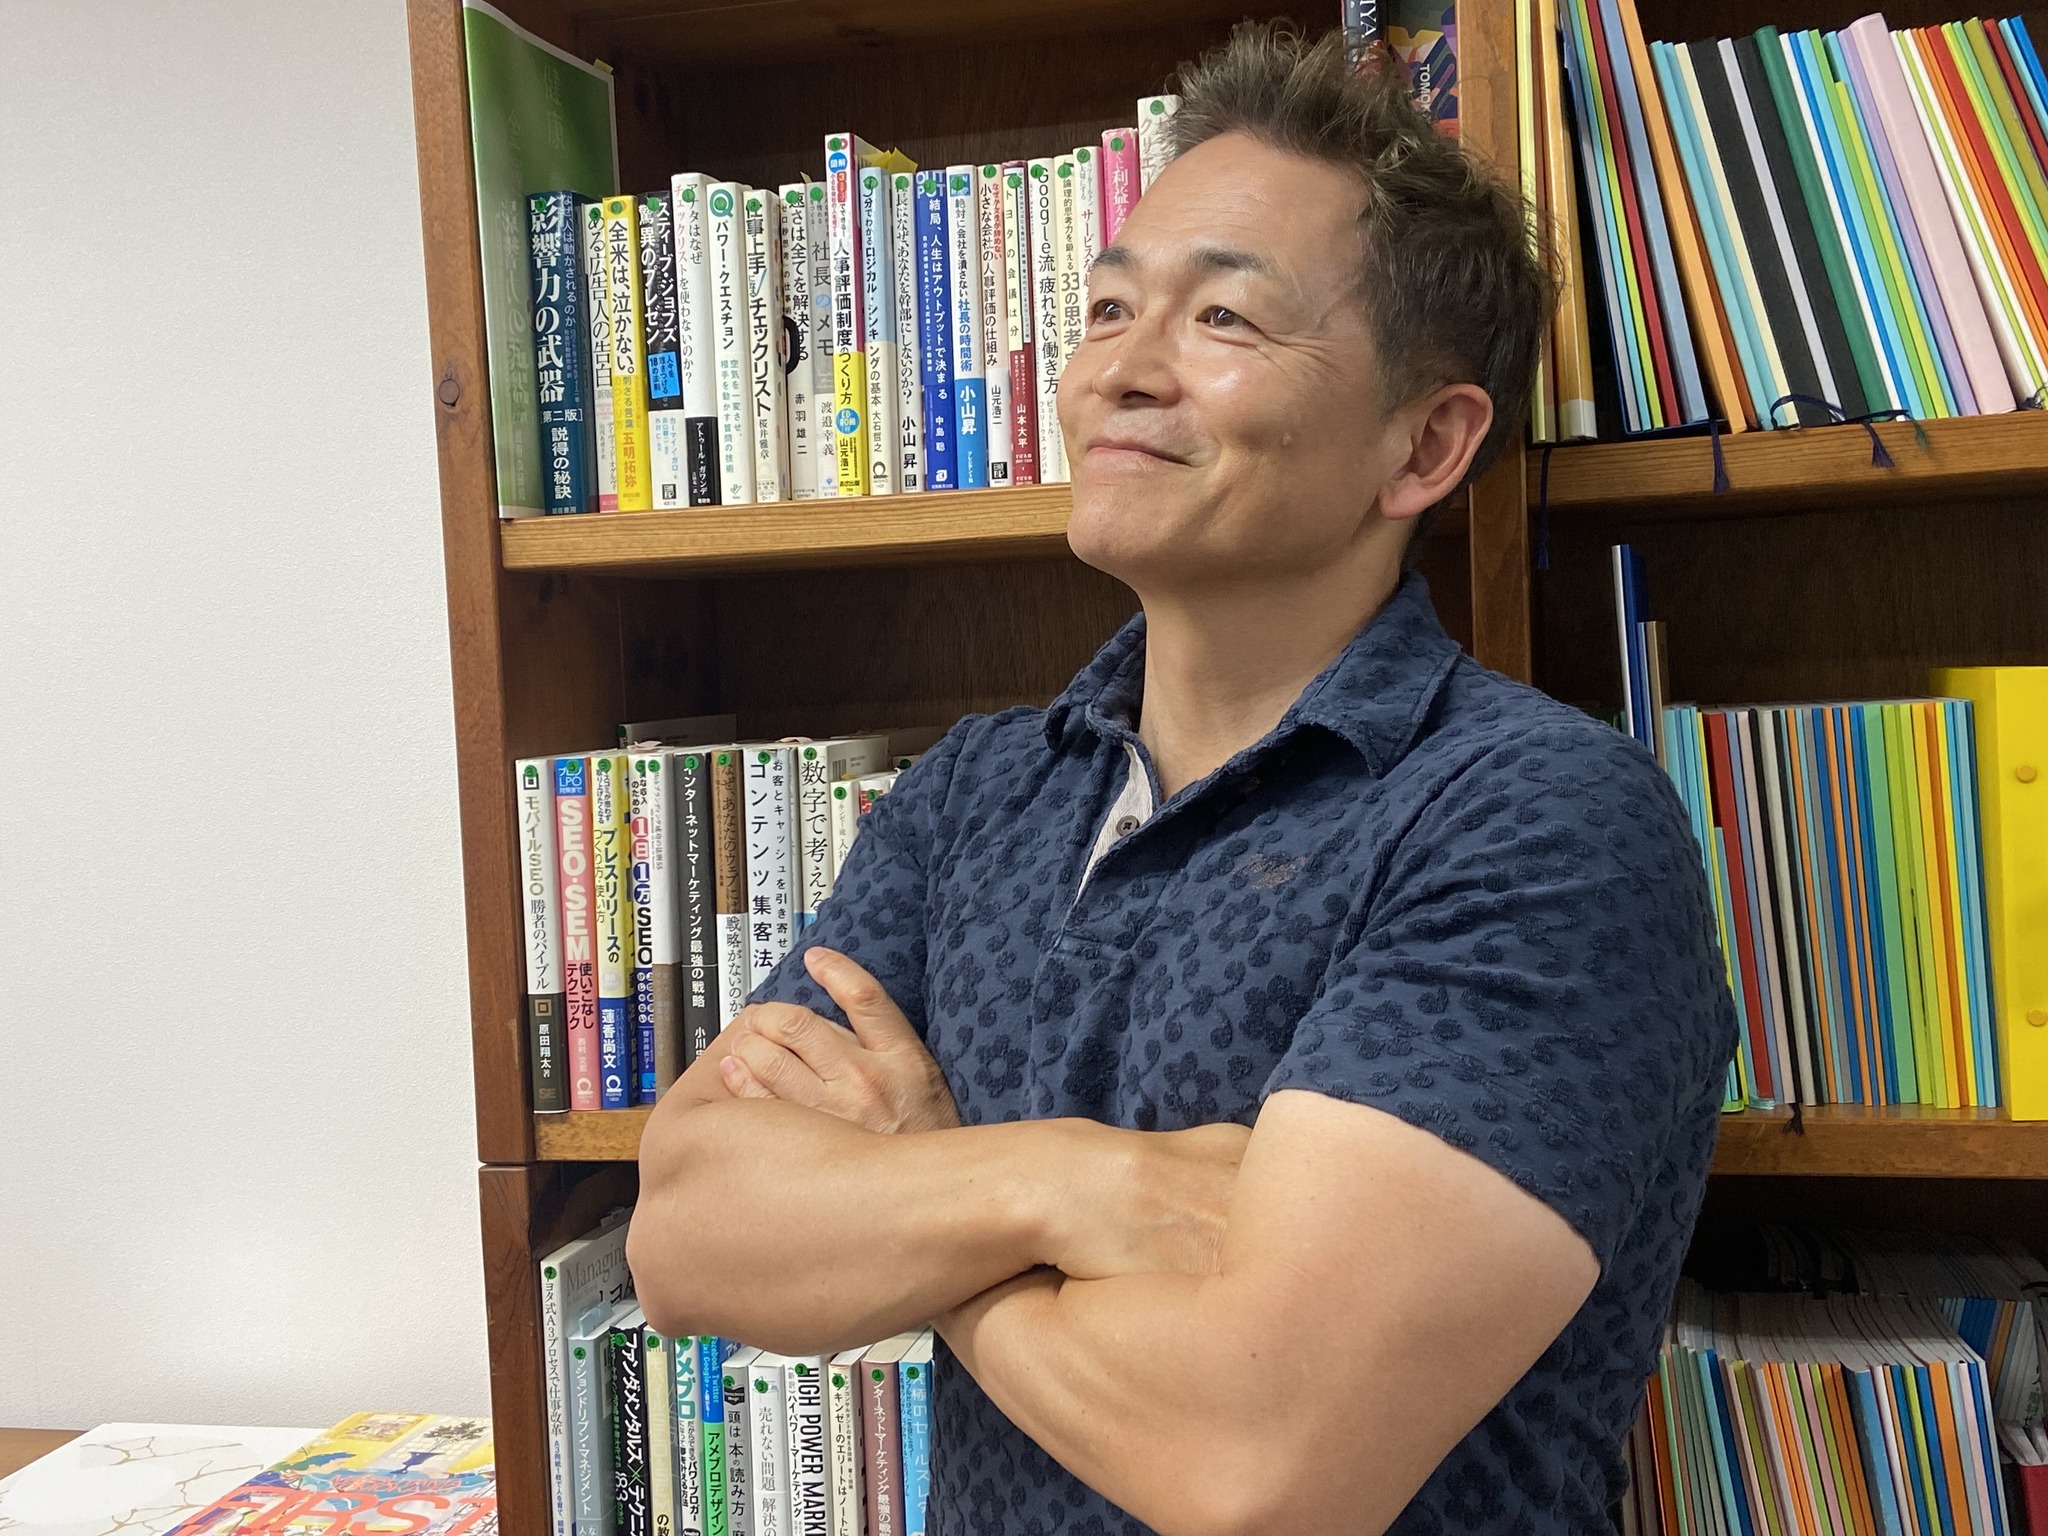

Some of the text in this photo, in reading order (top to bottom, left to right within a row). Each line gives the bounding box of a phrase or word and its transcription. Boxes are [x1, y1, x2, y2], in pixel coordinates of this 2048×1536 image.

[1113, 150, 1130, 240] ぐに利益を
[530, 195, 567, 405] 影響力の武器
[609, 220, 636, 375] 全米は、泣かない。
[639, 204, 660, 346] 驚異のプレゼン
[656, 202, 678, 344] スティーブ・ジョブズ
[716, 221, 735, 350] パワー・クエスチョン
[812, 240, 834, 357] 社長のメモ
[834, 240, 854, 406] 人事評価制度のつくり方
[895, 187, 915, 405] 長はなぜ、あなたを幹部にしないのか?
[929, 199, 949, 400] 結局、人生はアウトプットで決まる
[954, 198, 973, 373] 絶対に会社を潰さない社長の時間術
[980, 183, 998, 367] 小さな会社の人事評価の仕組み
[1039, 275, 1060, 395] 疲れない働き方
[551, 427, 572, 500] 説得の秘訣
[623, 432, 637, 488] 五明拓弥
[720, 361, 735, 475] 相手を動かす質問の技術
[795, 393, 807, 455] 赤羽雄二
[960, 385, 977, 436] 小山昇
[1015, 404, 1028, 449] 山本大平
[559, 777, 583, 788] LPO
[632, 780, 642, 815] のための
[524, 796, 545, 897] モバイルSEO
[603, 828, 622, 963] プレスリリースの
[750, 763, 774, 969] コンテンツ集客法
[531, 900, 550, 991] 勝者のバイブル
[566, 963, 580, 1031] テクニック
[579, 962, 595, 1029] 使いこなし
[601, 1009, 618, 1069] 蓮香尚文
[545, 1277, 563, 1438] ヨタ式A3プロセスで仕事改革
[712, 1374, 720, 1403] Twitter
[575, 1357, 593, 1516] ッションドリブン・マネジメント
[708, 1434, 725, 1536] アメブロデザイン
[758, 1406, 776, 1492] 売れない問題
[788, 1395, 804, 1519] ハイパワー・マーケティング
[799, 1367, 828, 1536] HIGH POWER MARK
[834, 1384, 849, 1536] キンゼーのエリートはノートに
[873, 1381, 893, 1536] ンターネットマーケティング最強の戦
